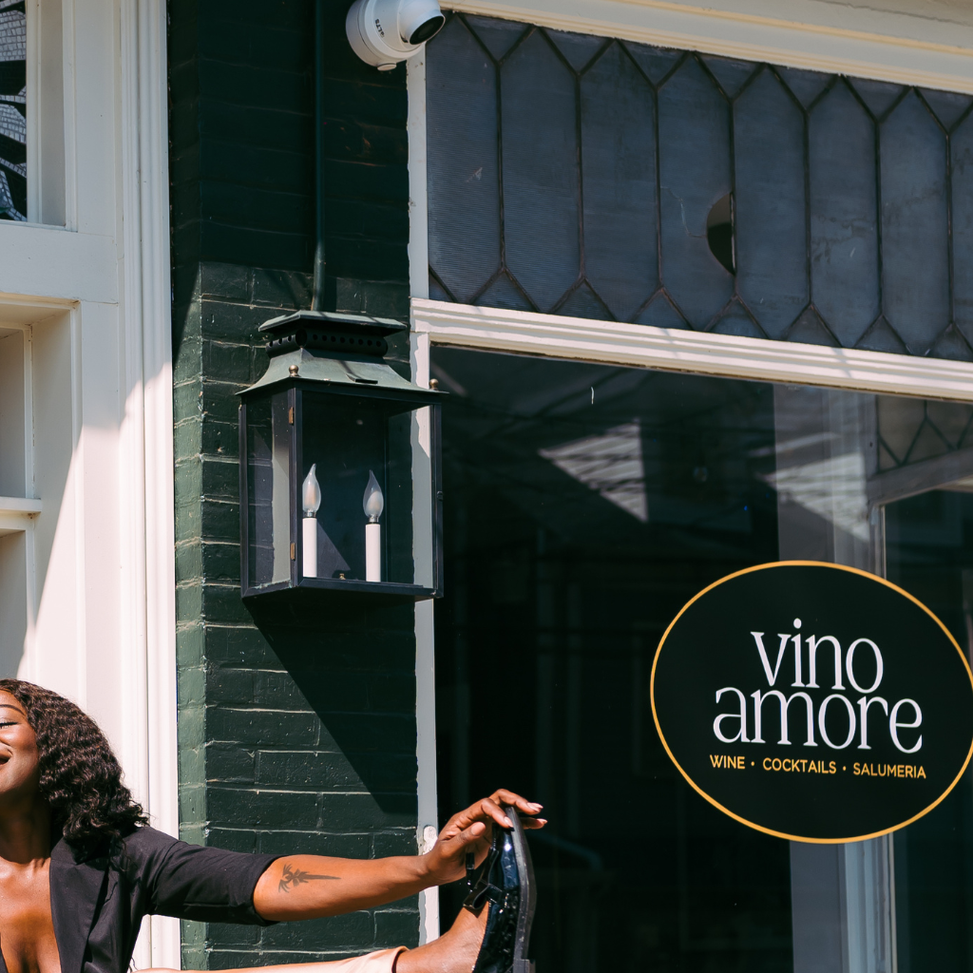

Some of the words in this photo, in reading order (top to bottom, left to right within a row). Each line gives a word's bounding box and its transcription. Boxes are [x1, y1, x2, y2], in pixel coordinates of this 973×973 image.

[750, 618, 884, 694] vino
[712, 687, 923, 754] amore
[709, 754, 746, 770] WINE
[762, 757, 837, 775] COCKTAILS
[853, 762, 927, 780] SALUMERIA
